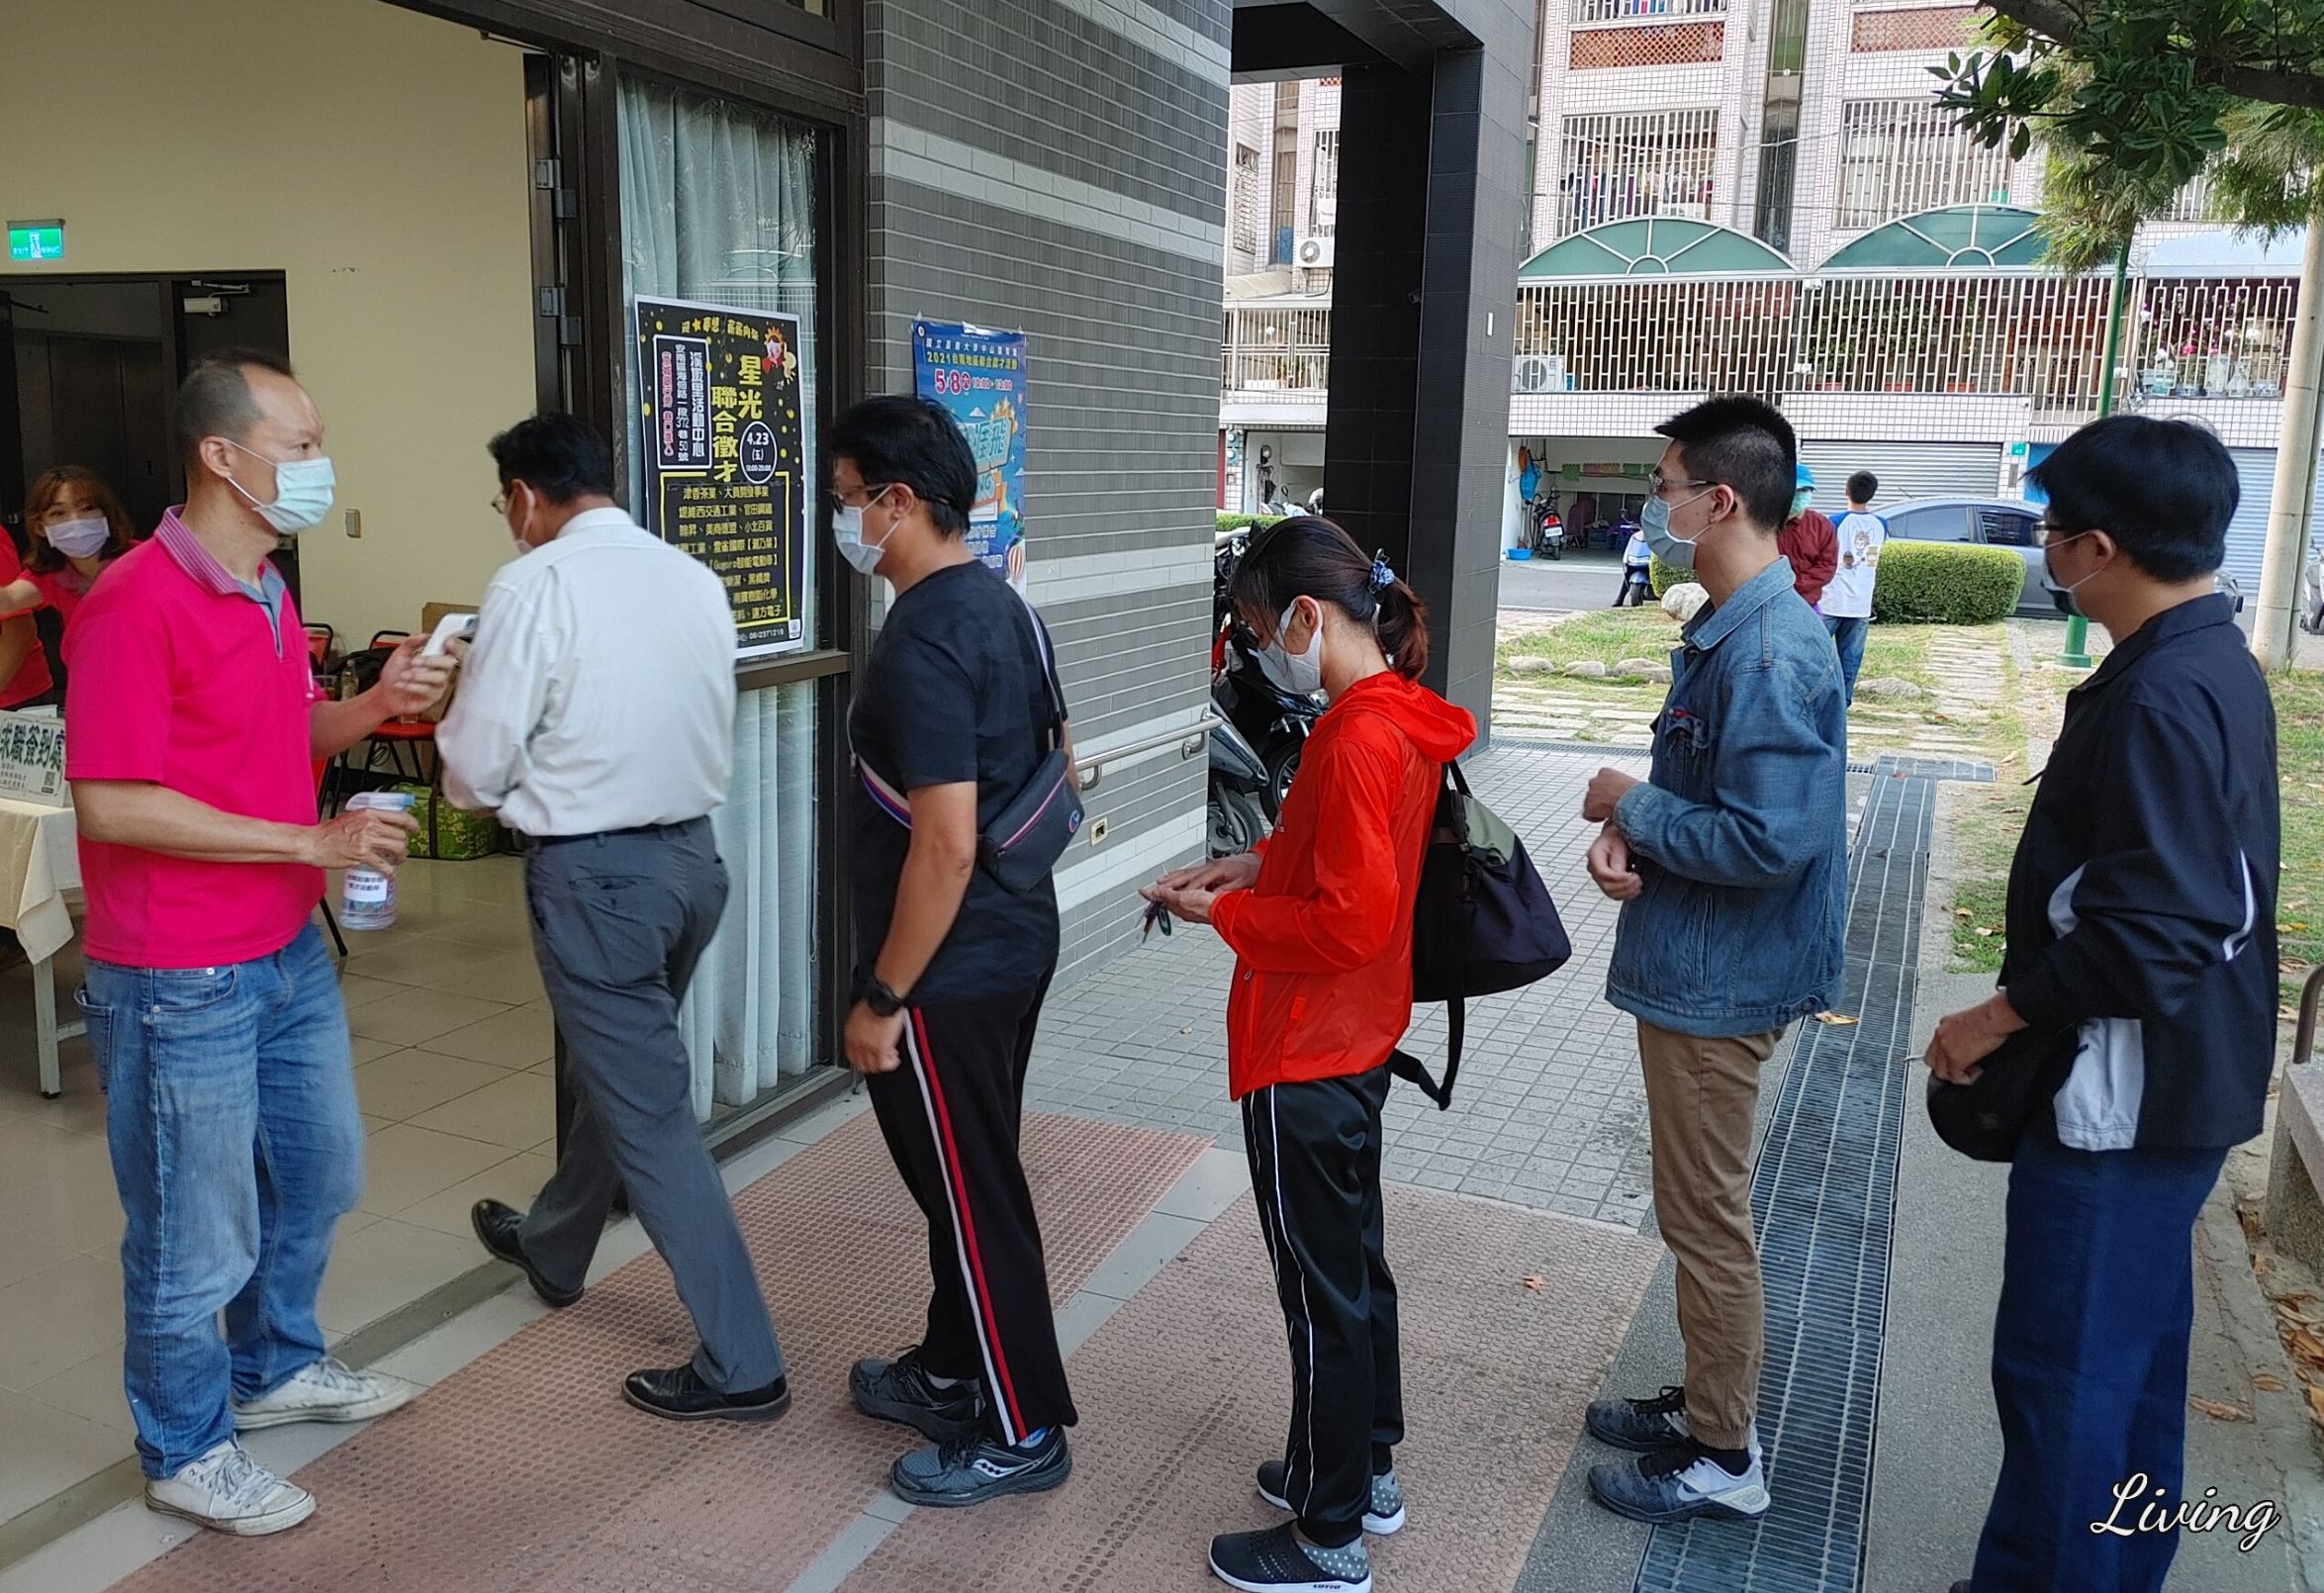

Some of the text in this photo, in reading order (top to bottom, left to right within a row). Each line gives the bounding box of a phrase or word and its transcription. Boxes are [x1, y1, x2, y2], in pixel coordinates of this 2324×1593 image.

[738, 354, 763, 420] 星光
[711, 386, 738, 482] 聯合徵才
[746, 432, 770, 445] 4.23
